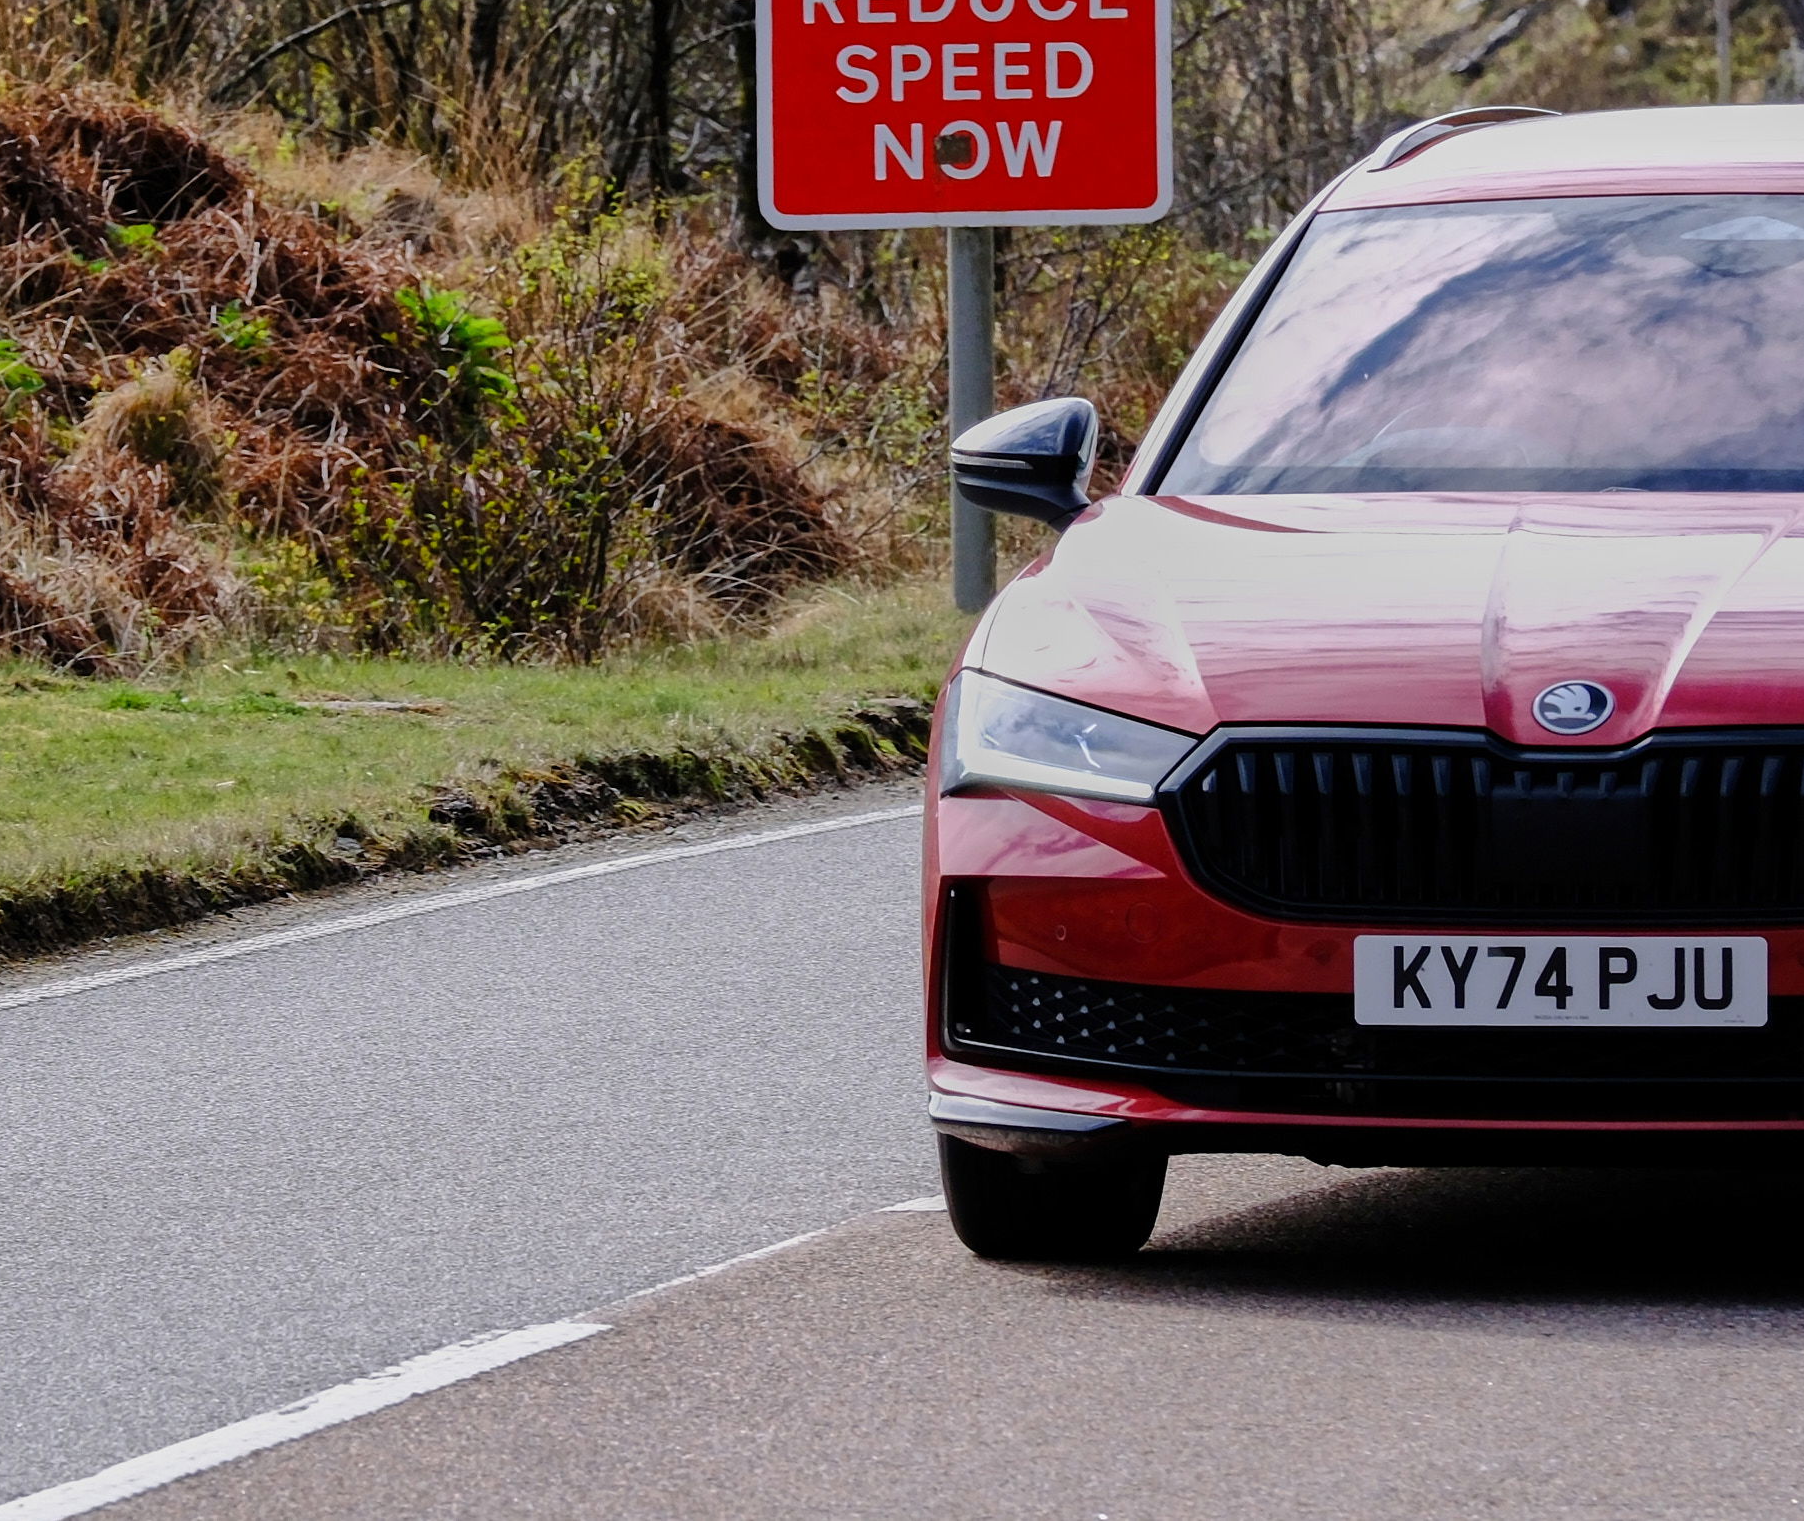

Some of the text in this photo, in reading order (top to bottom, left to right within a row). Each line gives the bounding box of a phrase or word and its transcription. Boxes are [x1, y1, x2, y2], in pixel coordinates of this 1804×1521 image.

[835, 41, 1094, 104] SPEED
[874, 119, 1063, 181] NOW
[1393, 945, 1733, 1011] KY74 PJU
